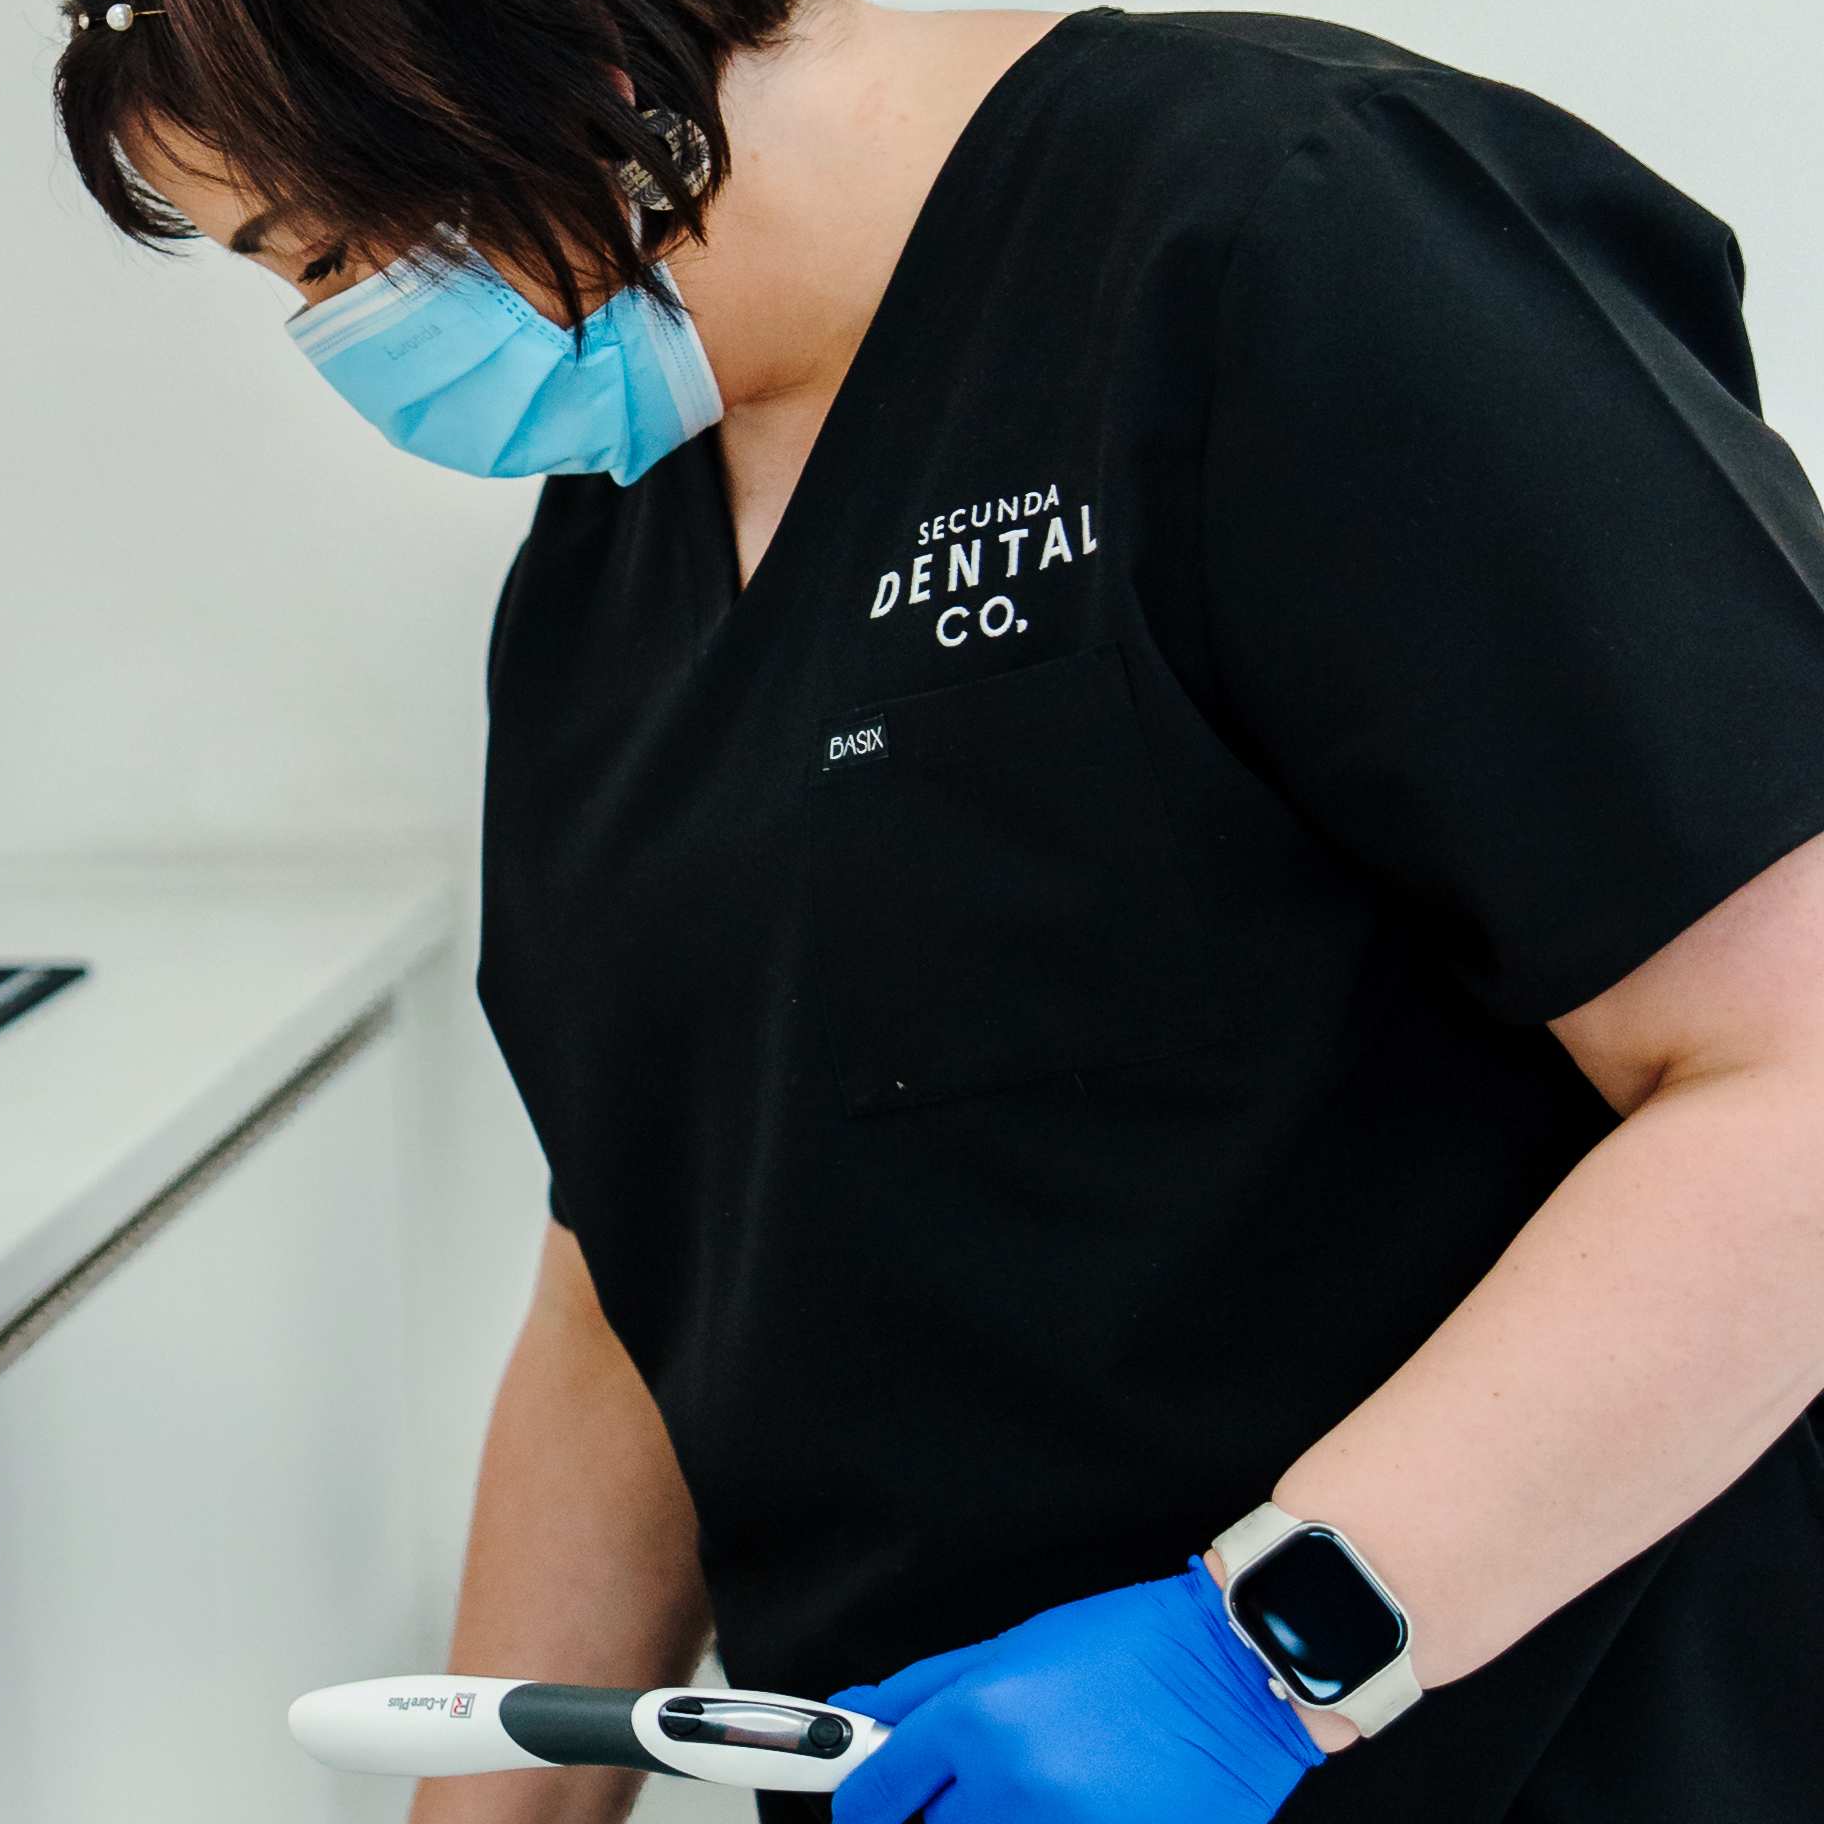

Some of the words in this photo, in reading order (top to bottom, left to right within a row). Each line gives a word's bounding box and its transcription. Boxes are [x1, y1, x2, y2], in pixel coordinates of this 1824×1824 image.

[917, 483, 1061, 546] SECUNDA
[869, 504, 1098, 620] DENTAL
[828, 725, 885, 761] BASIX
[387, 1696, 412, 1711] Plus
